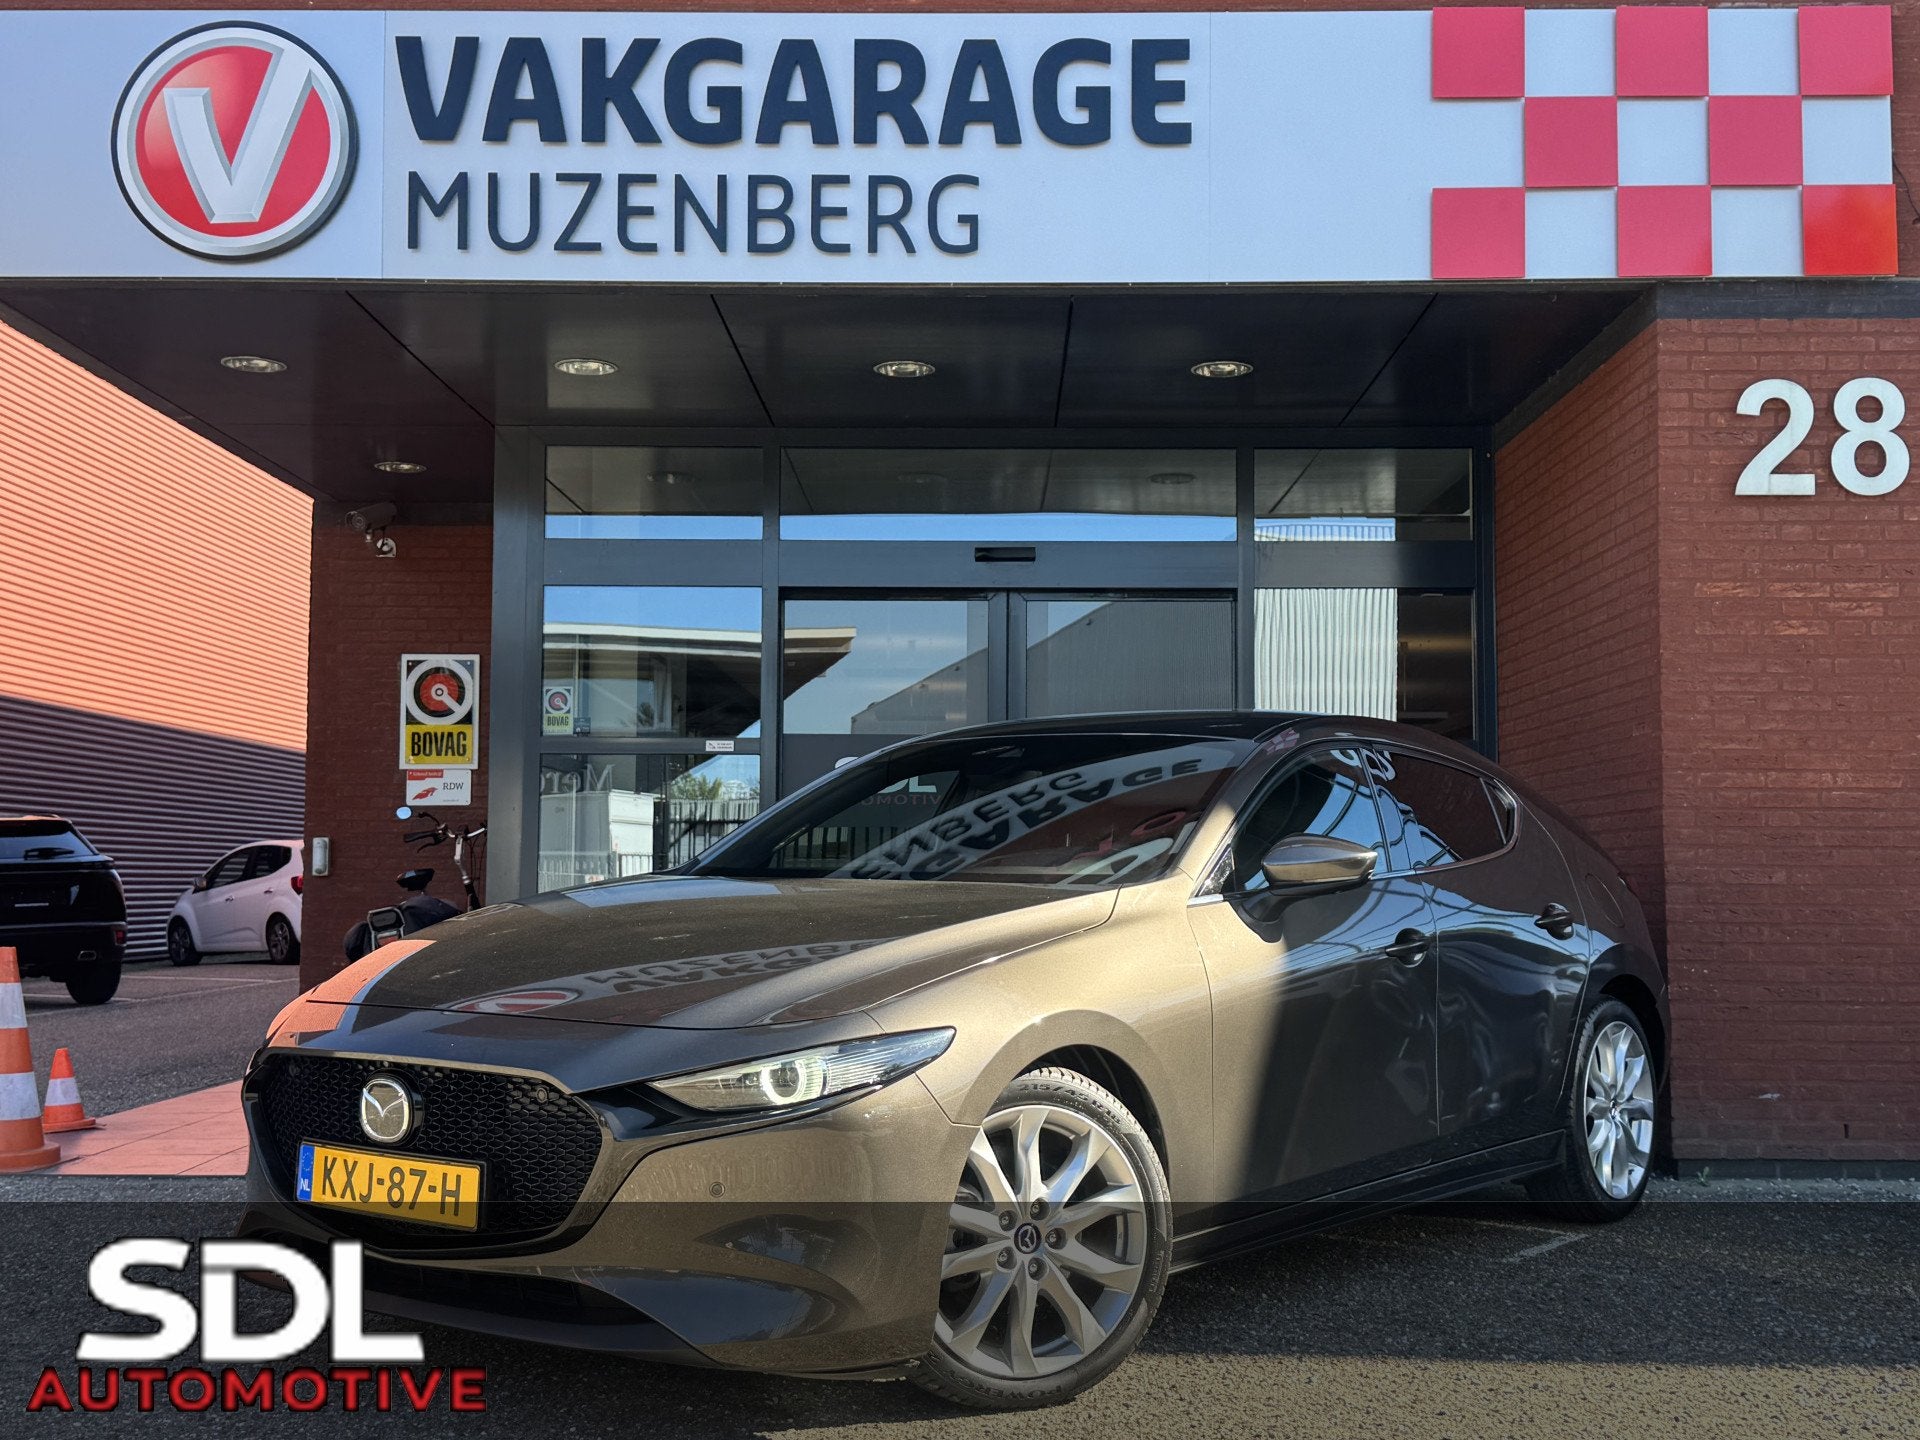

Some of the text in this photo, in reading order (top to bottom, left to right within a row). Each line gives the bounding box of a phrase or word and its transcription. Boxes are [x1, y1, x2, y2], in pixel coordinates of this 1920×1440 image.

[395, 36, 1192, 146] VAKGARAGE
[408, 171, 980, 254] MUZENBERG
[1735, 377, 1910, 496] 28
[547, 716, 569, 726] BOVAG
[411, 731, 467, 757] BOVAG
[443, 782, 464, 790] RDW
[300, 1178, 311, 1192] NL
[321, 1155, 462, 1217] KXJ-87-H
